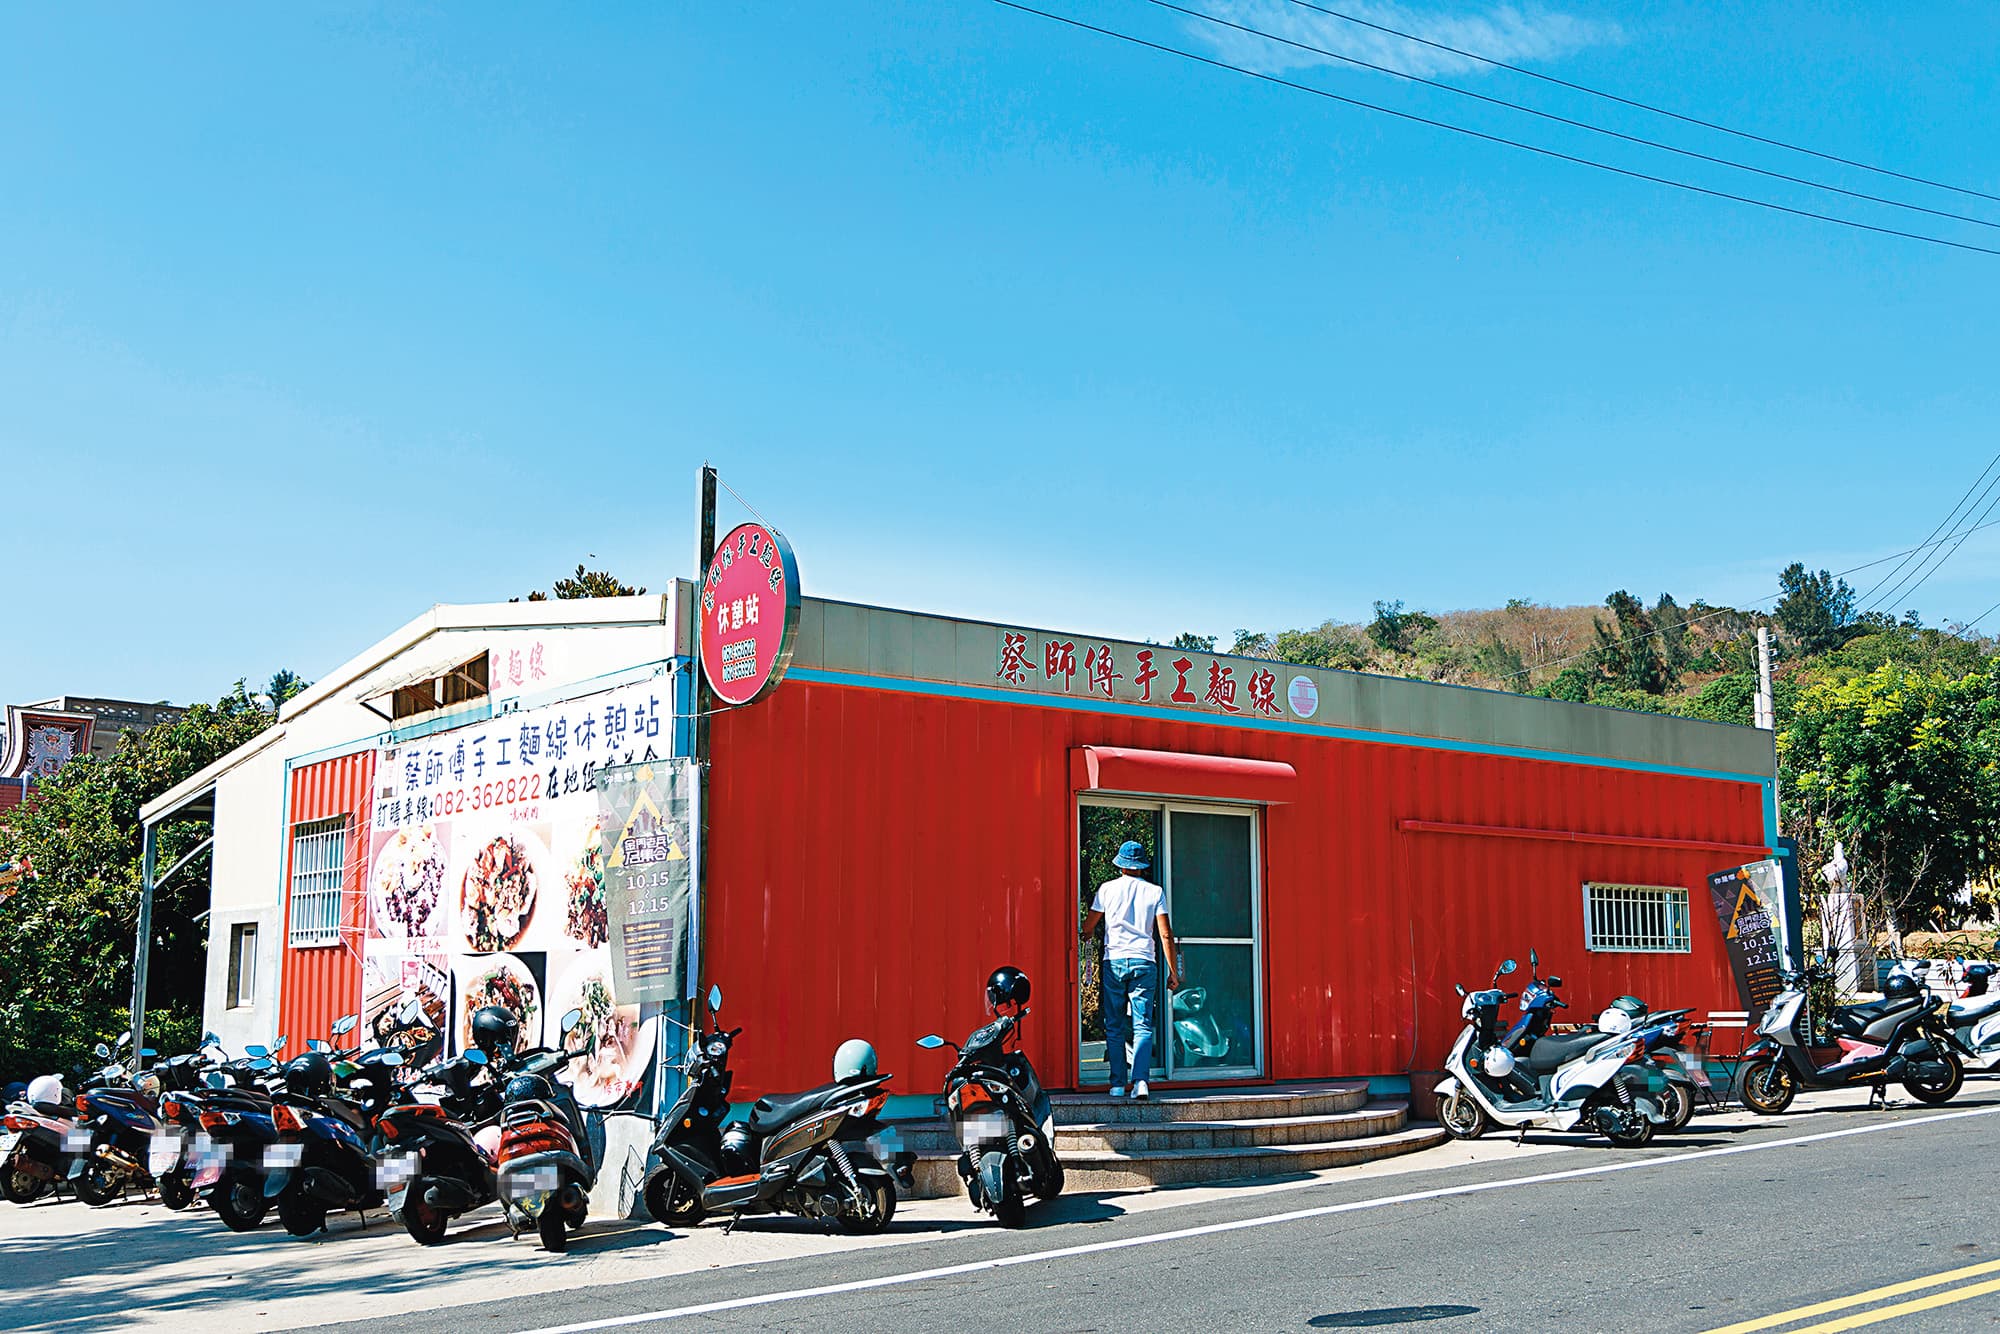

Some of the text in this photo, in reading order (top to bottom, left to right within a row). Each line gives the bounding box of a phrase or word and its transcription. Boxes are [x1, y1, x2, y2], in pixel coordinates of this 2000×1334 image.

[718, 593, 759, 635] 休憩站
[996, 630, 1284, 717] 蔡師傅手工麵線
[404, 694, 660, 791] 蔡師傅手工麵線休憩站
[627, 872, 669, 889] 10.15
[629, 897, 669, 915] 12.15
[1742, 934, 1776, 951] 10.15
[1746, 952, 1778, 967] 12.15
